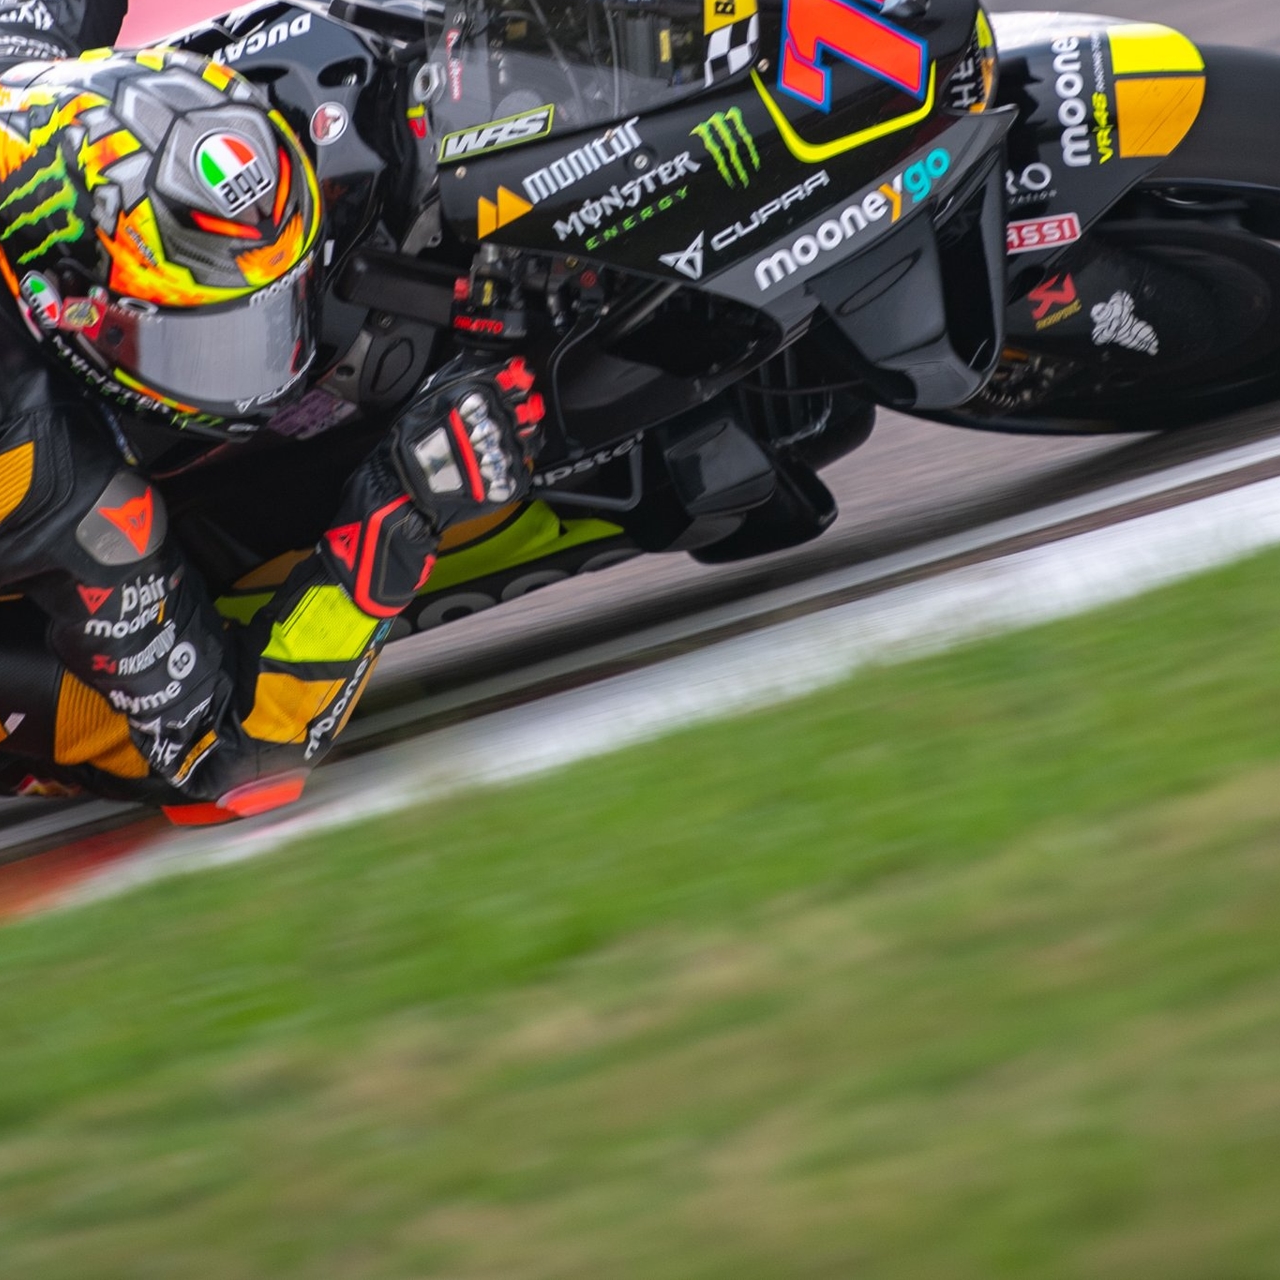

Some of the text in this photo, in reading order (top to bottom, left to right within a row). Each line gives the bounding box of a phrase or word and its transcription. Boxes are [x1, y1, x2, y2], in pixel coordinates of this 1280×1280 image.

[585, 185, 688, 251] ENERGY
[711, 169, 830, 251] CUPRA
[84, 596, 169, 638] mooney
[172, 651, 191, 672] to
